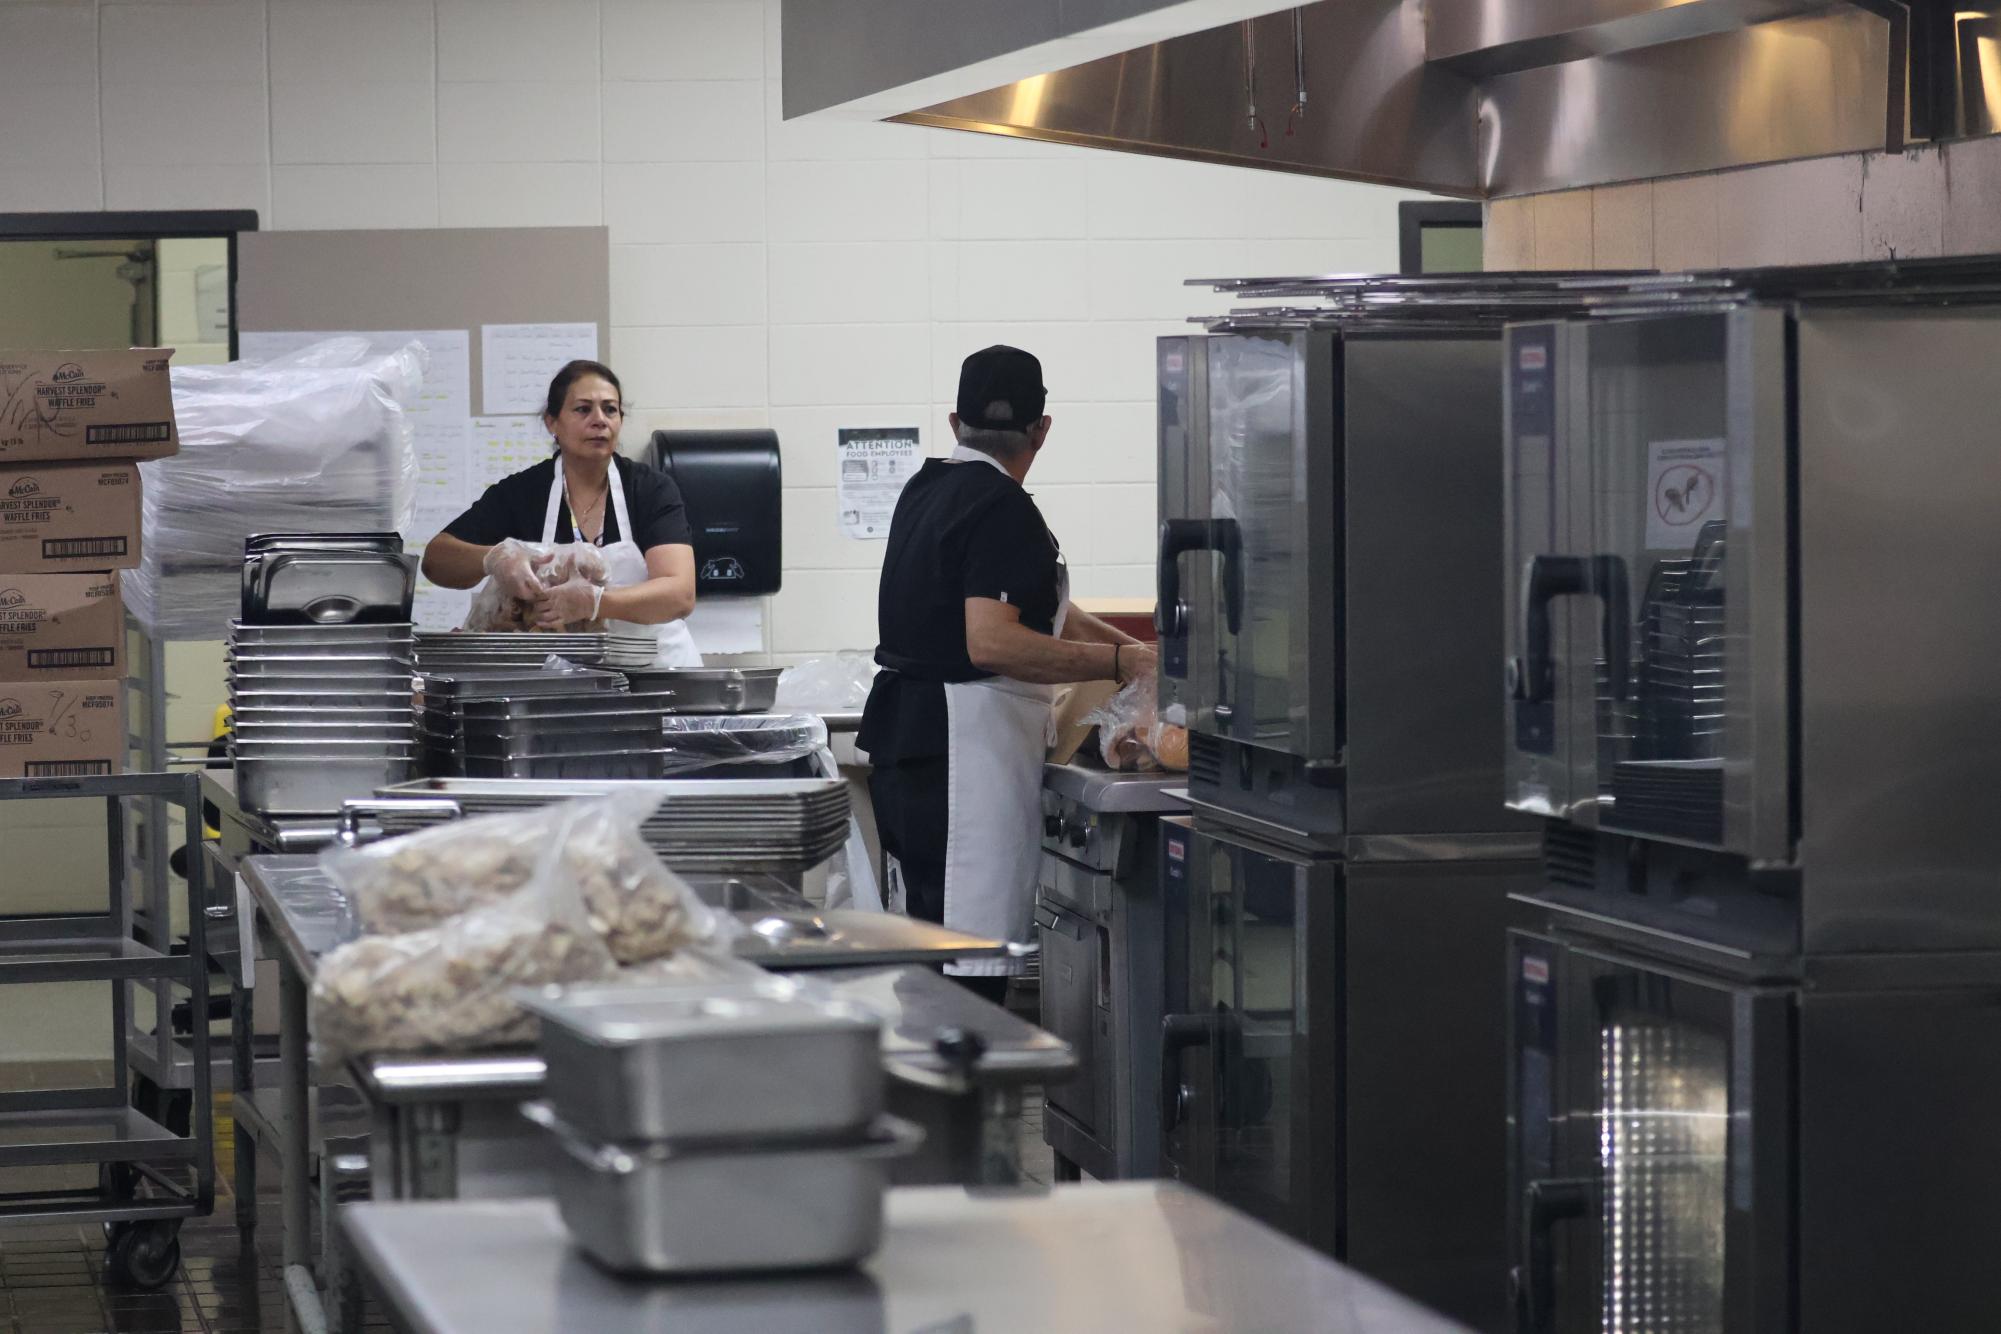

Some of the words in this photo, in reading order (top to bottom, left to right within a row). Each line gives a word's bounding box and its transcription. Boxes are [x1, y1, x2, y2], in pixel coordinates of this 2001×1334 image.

[58, 368, 84, 380] McCain
[37, 386, 66, 396] HARVEST
[48, 398, 75, 408] WAFFLE
[76, 397, 95, 407] FRIES
[847, 440, 911, 450] ATTENTION
[15, 483, 40, 495] McCain
[4, 512, 30, 522] WAFFLE
[31, 511, 50, 521] FRIES
[16, 622, 36, 631] FRIES
[13, 733, 33, 743] FRIES
